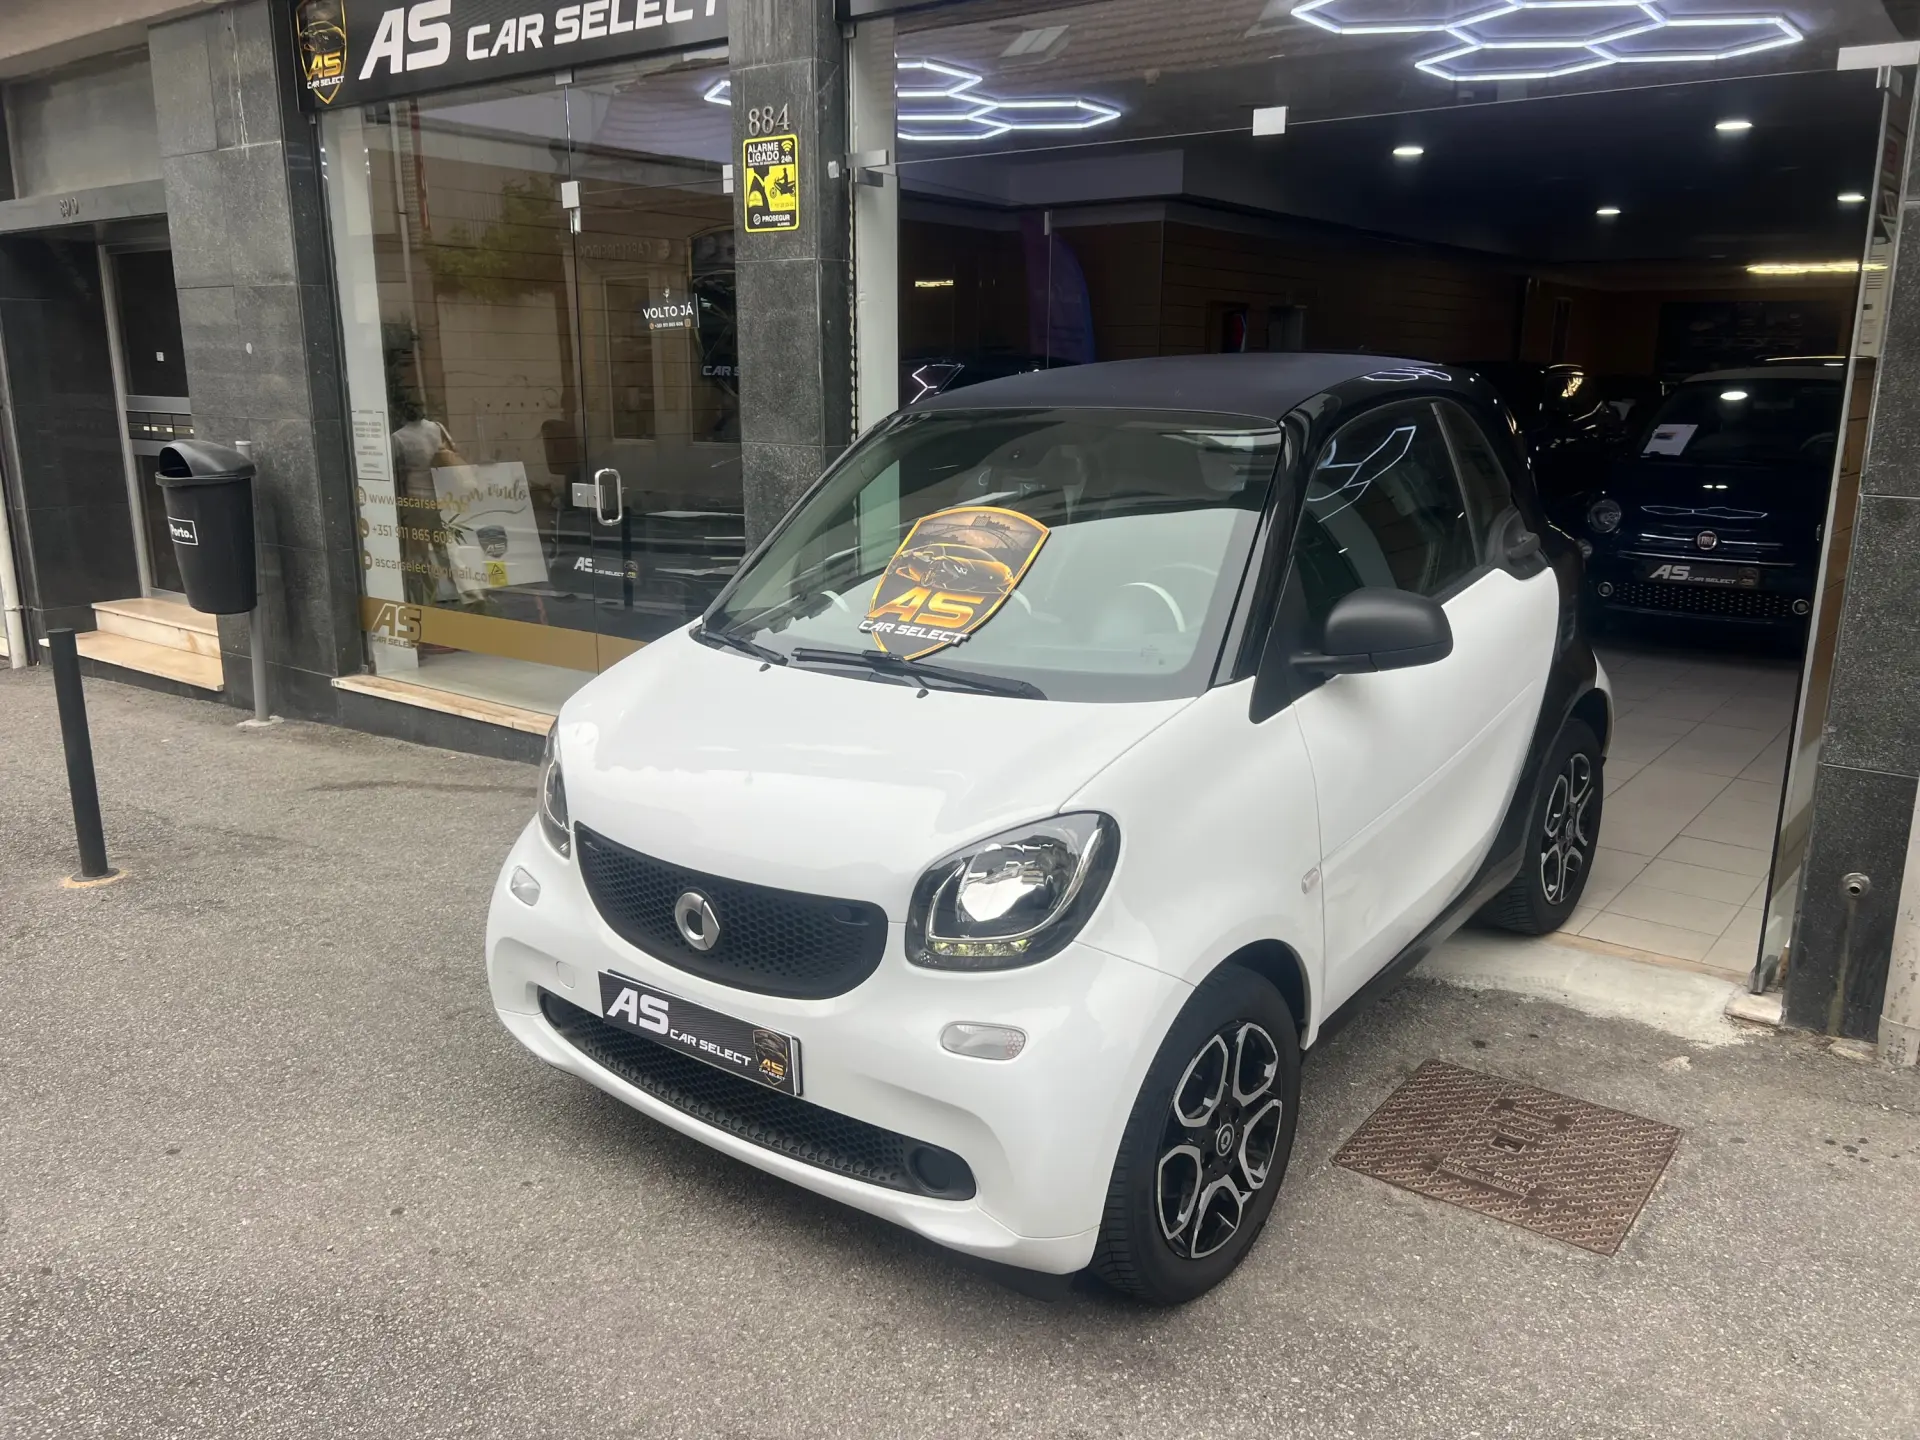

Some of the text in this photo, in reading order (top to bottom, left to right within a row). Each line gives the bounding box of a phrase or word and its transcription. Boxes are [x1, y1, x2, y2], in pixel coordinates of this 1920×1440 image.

[359, 0, 451, 80] AS
[466, 13, 544, 60] CAR
[307, 51, 342, 80] AS
[307, 75, 344, 89] CAR SELECT
[748, 103, 790, 137] 884
[747, 150, 779, 163] LIGADO
[748, 142, 779, 153] ALARME
[761, 213, 791, 223] PROSEGUR
[643, 301, 694, 319] VOLTO JÁ
[702, 365, 731, 376] CAR
[372, 523, 393, 537] +351
[411, 527, 431, 542] 865
[1649, 564, 1691, 580] AS
[1705, 577, 1737, 585] SELECT
[865, 586, 986, 628] AS
[371, 602, 422, 643] AS
[858, 619, 969, 644] CAR SELECT
[606, 987, 752, 1067] AS CAR SELECT
[760, 1058, 784, 1076] AS
[1440, 1163, 1528, 1195] SANEAMENTO
[1493, 1171, 1537, 1189] PORTO
